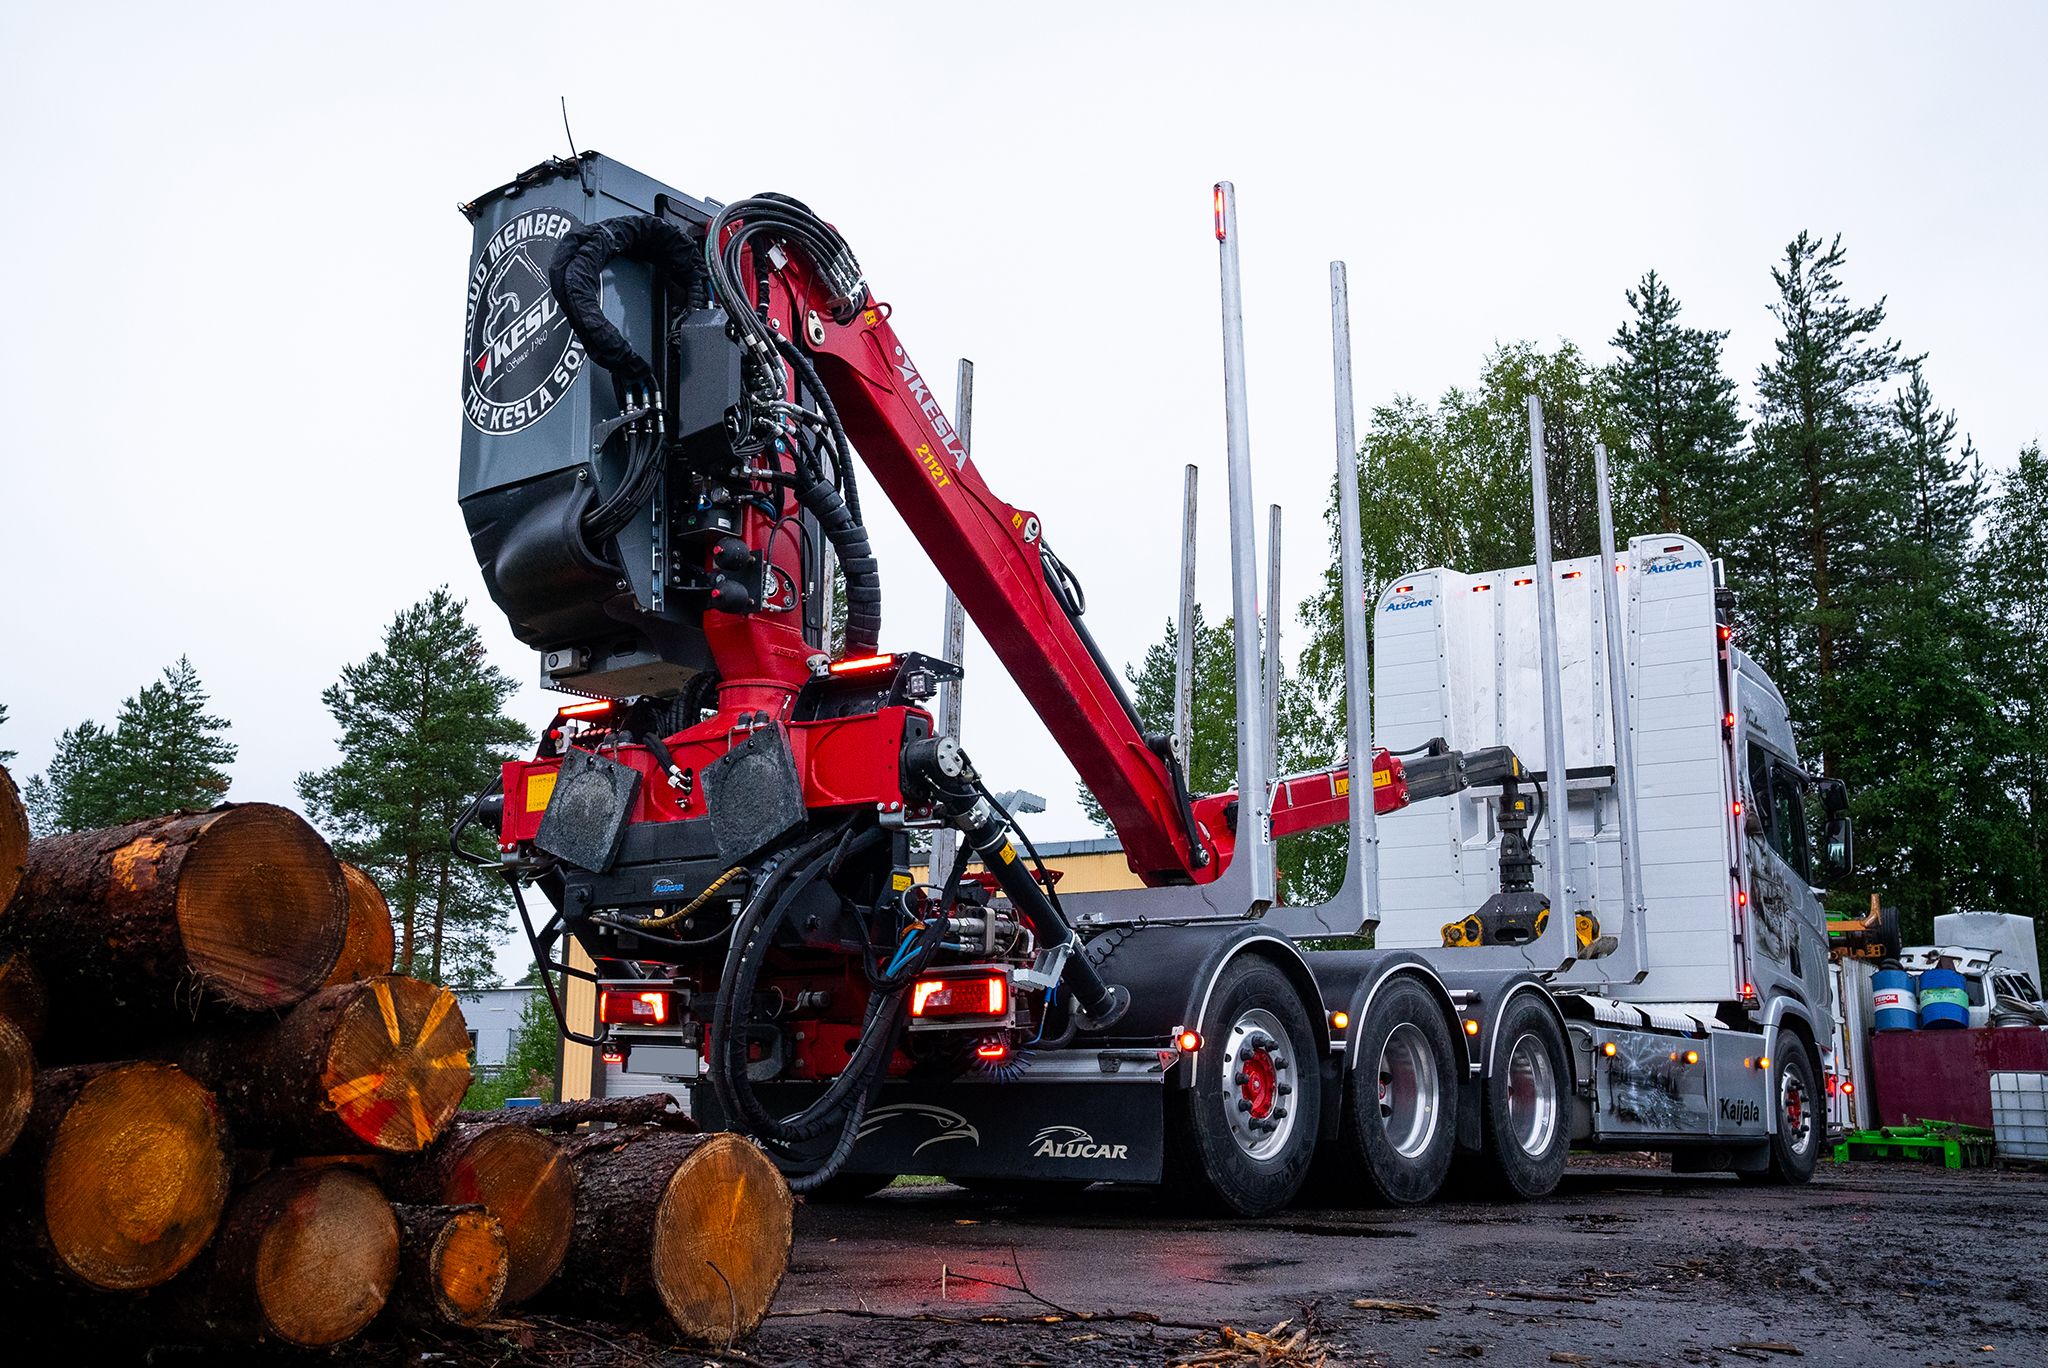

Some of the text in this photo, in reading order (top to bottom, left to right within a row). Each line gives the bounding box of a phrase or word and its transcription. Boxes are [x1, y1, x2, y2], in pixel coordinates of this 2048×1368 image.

[489, 213, 571, 262] MEMBER
[505, 329, 548, 373] Since 1960
[465, 386, 490, 425] THE
[489, 387, 554, 429] KESLA
[908, 376, 968, 472] KESLA
[915, 443, 951, 488] 2112T
[1646, 560, 1703, 576] ALUCAR
[1385, 599, 1433, 612] ALUCAR
[1719, 1098, 1760, 1127] Kaijala
[1033, 1139, 1128, 1160] ALUCAR
